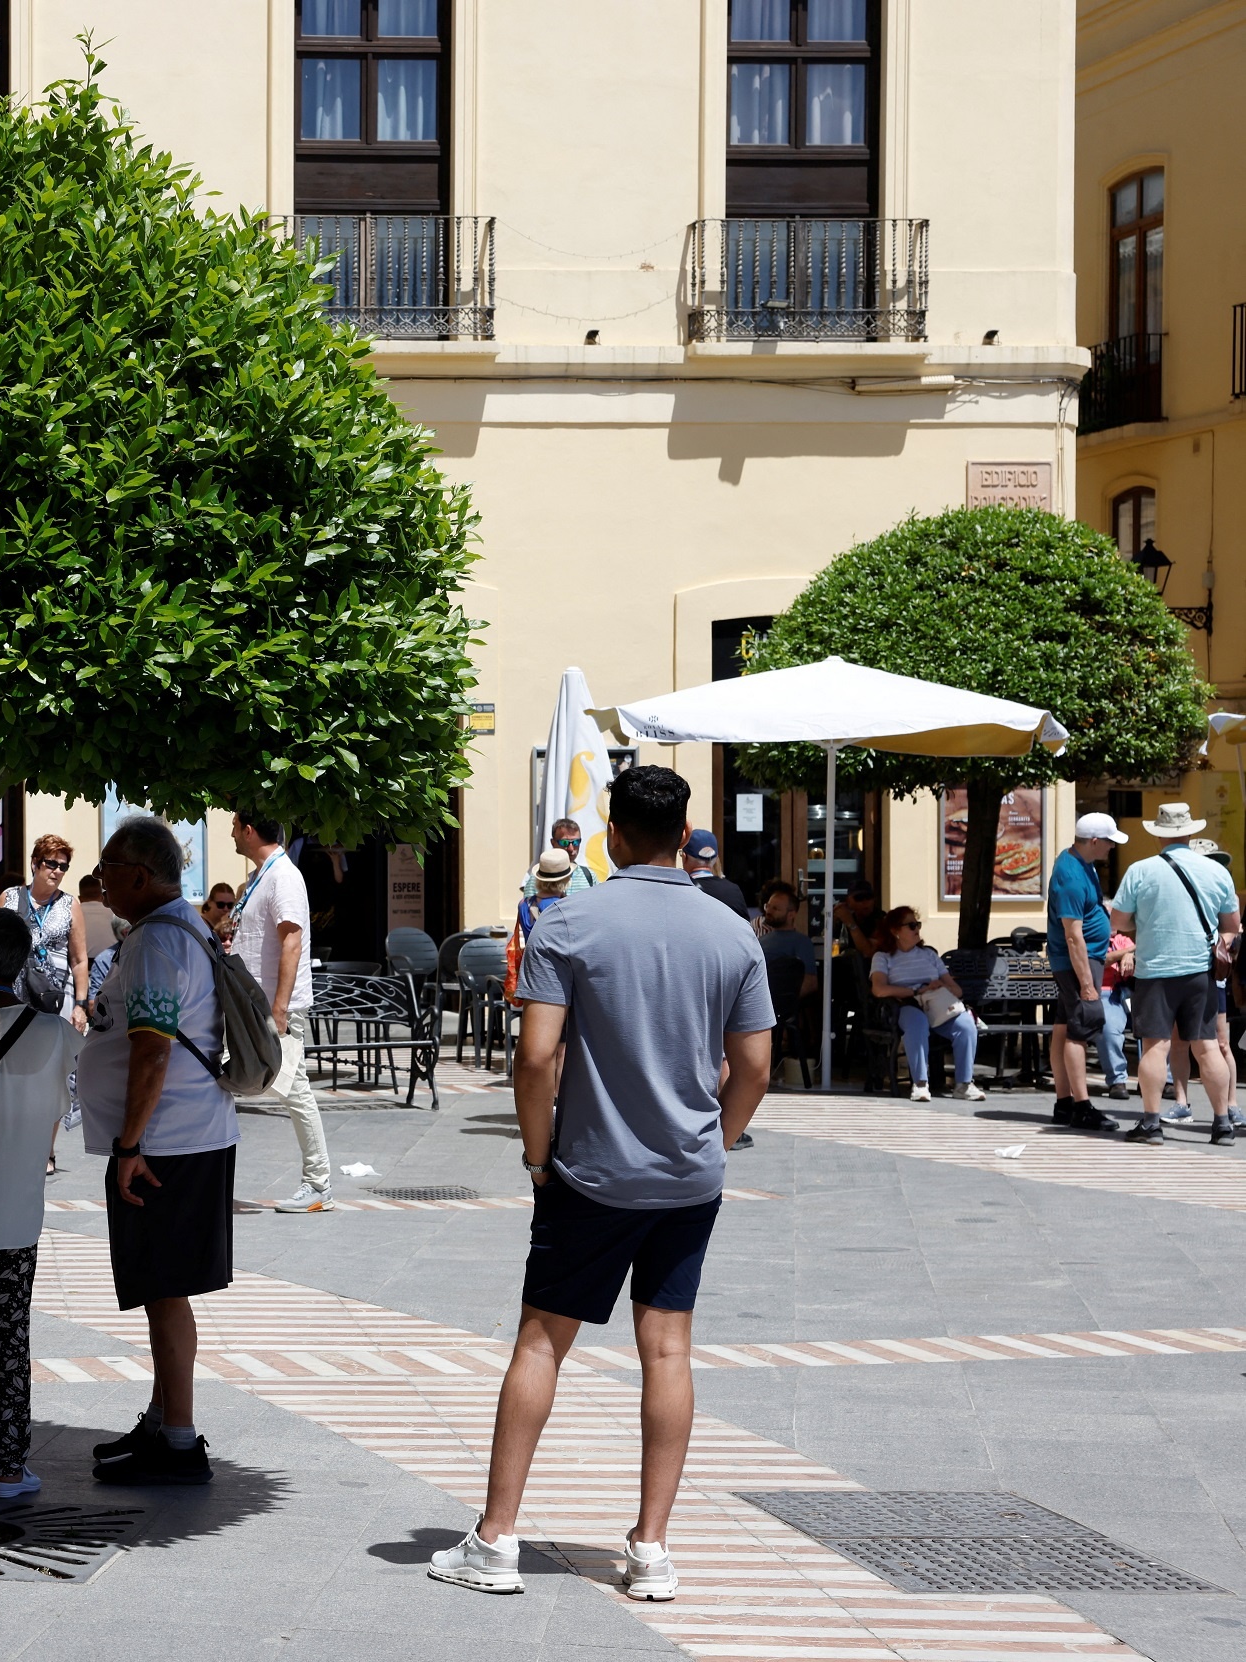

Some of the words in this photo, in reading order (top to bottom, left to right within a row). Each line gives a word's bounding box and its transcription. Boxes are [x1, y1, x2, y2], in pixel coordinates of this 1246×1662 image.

[980, 470, 1038, 488] EDIFICIO
[636, 730, 675, 738] BLISS
[1001, 793, 1015, 805] AS
[392, 882, 421, 893] ESPERE
